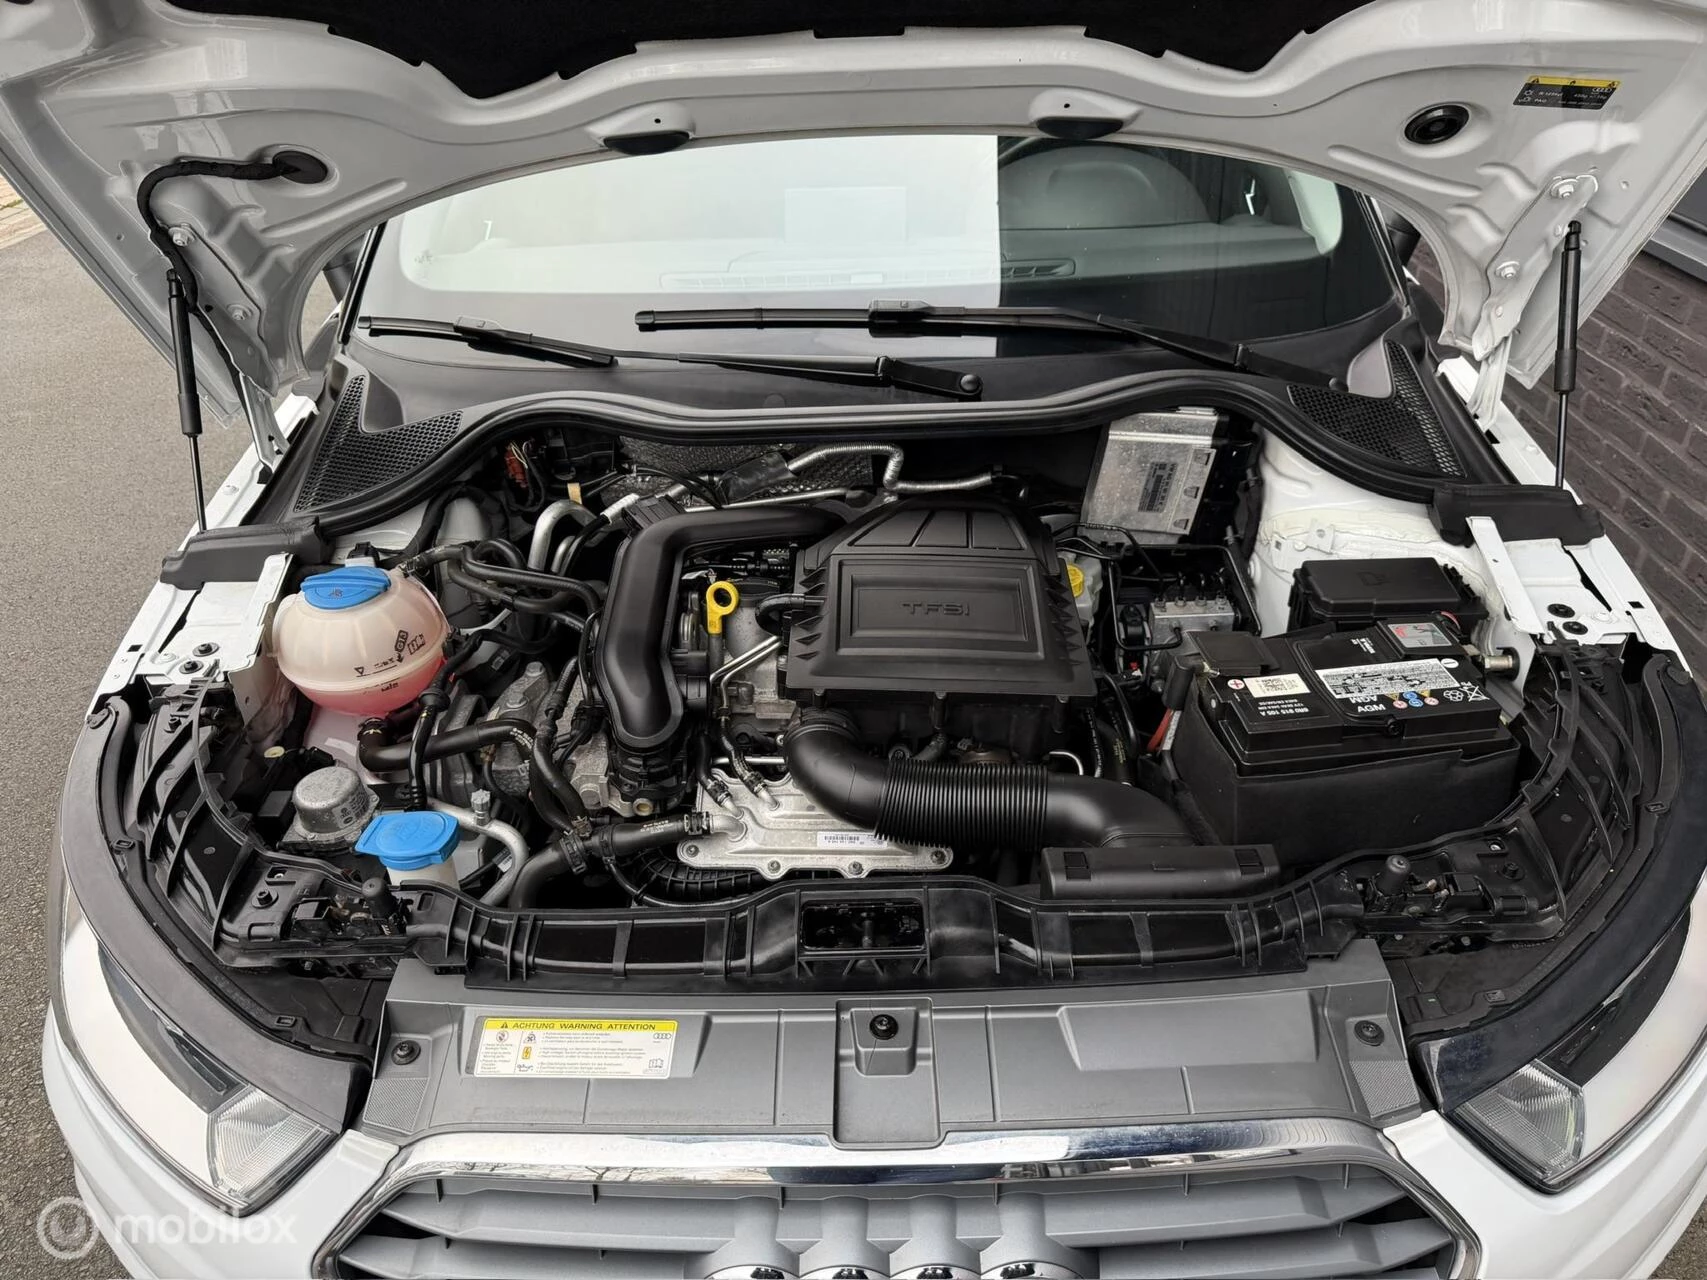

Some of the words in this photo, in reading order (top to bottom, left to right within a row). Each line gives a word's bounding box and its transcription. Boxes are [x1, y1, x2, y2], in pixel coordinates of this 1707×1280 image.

[902, 603, 970, 616] TFSI
[1357, 703, 1386, 713] AGM
[607, 1023, 657, 1031] ATTENTION
